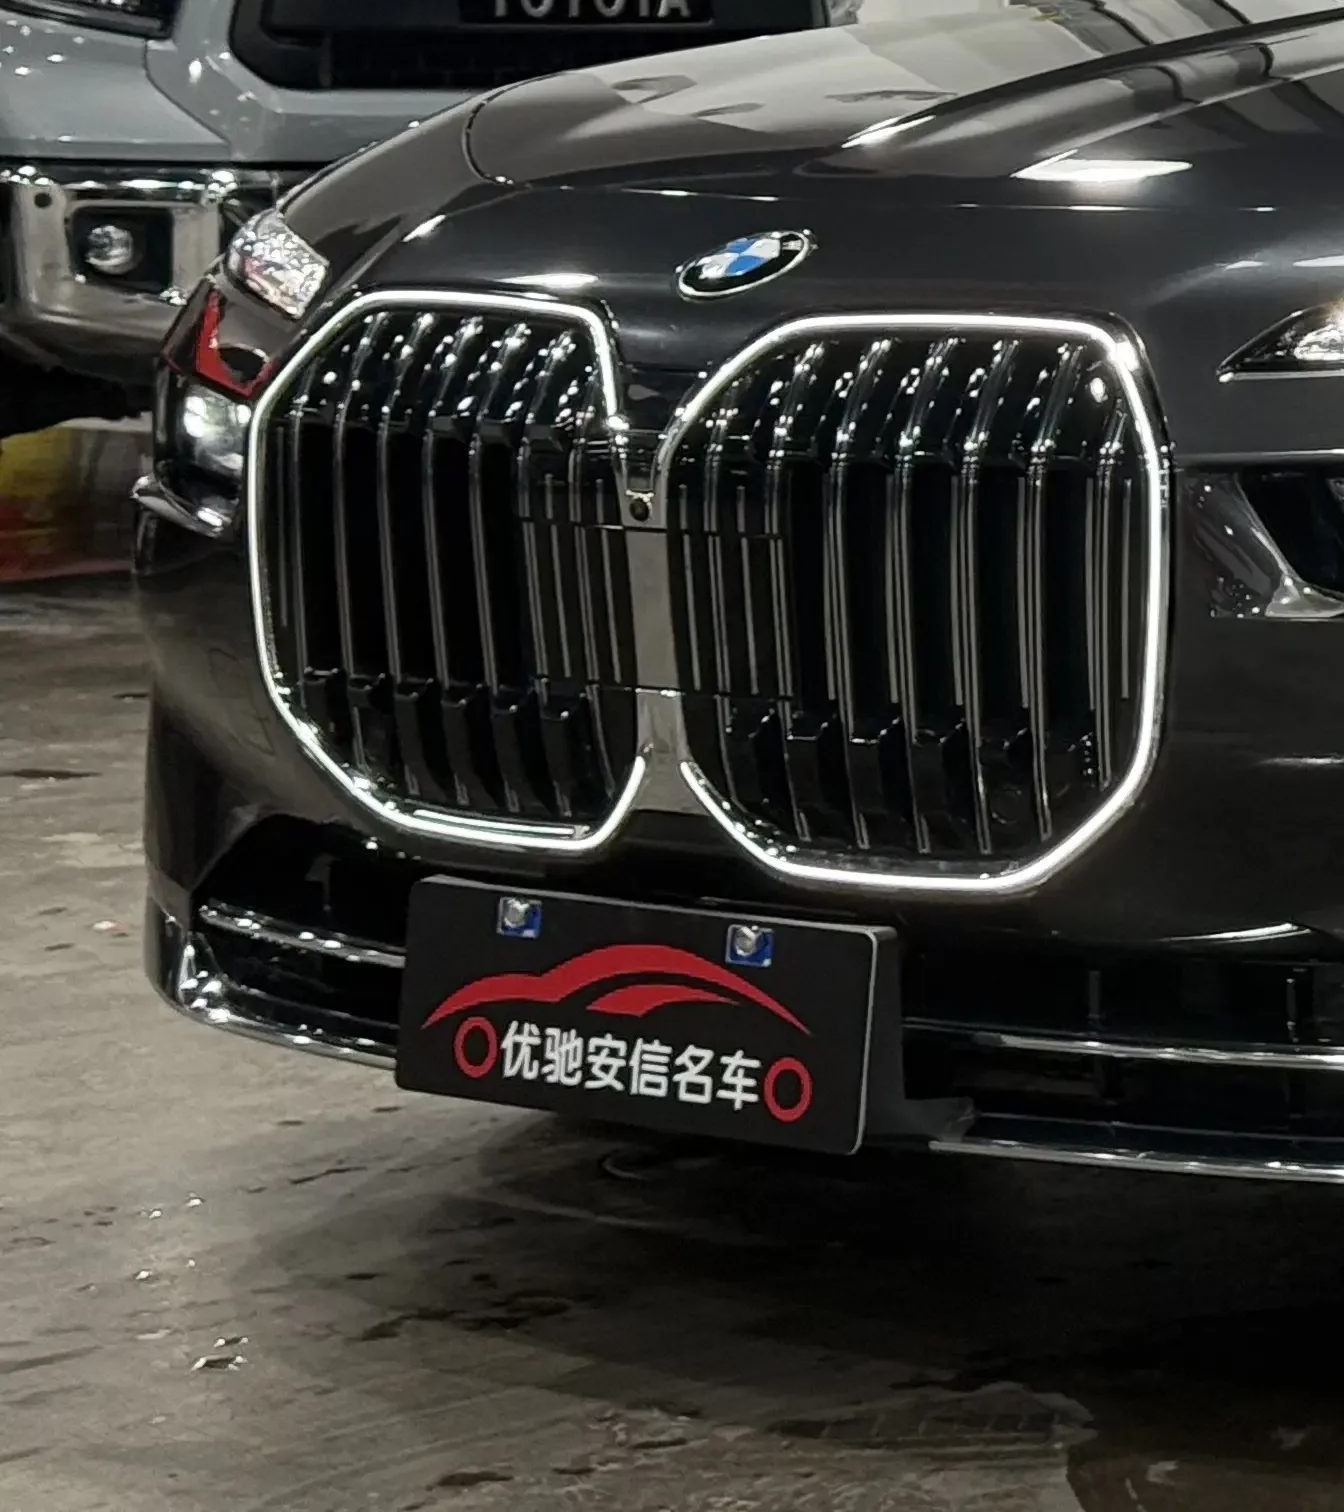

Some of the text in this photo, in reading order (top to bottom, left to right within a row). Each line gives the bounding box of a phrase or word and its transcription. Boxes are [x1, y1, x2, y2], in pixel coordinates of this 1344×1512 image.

[501, 1020, 763, 1111] 优驰安信名车
